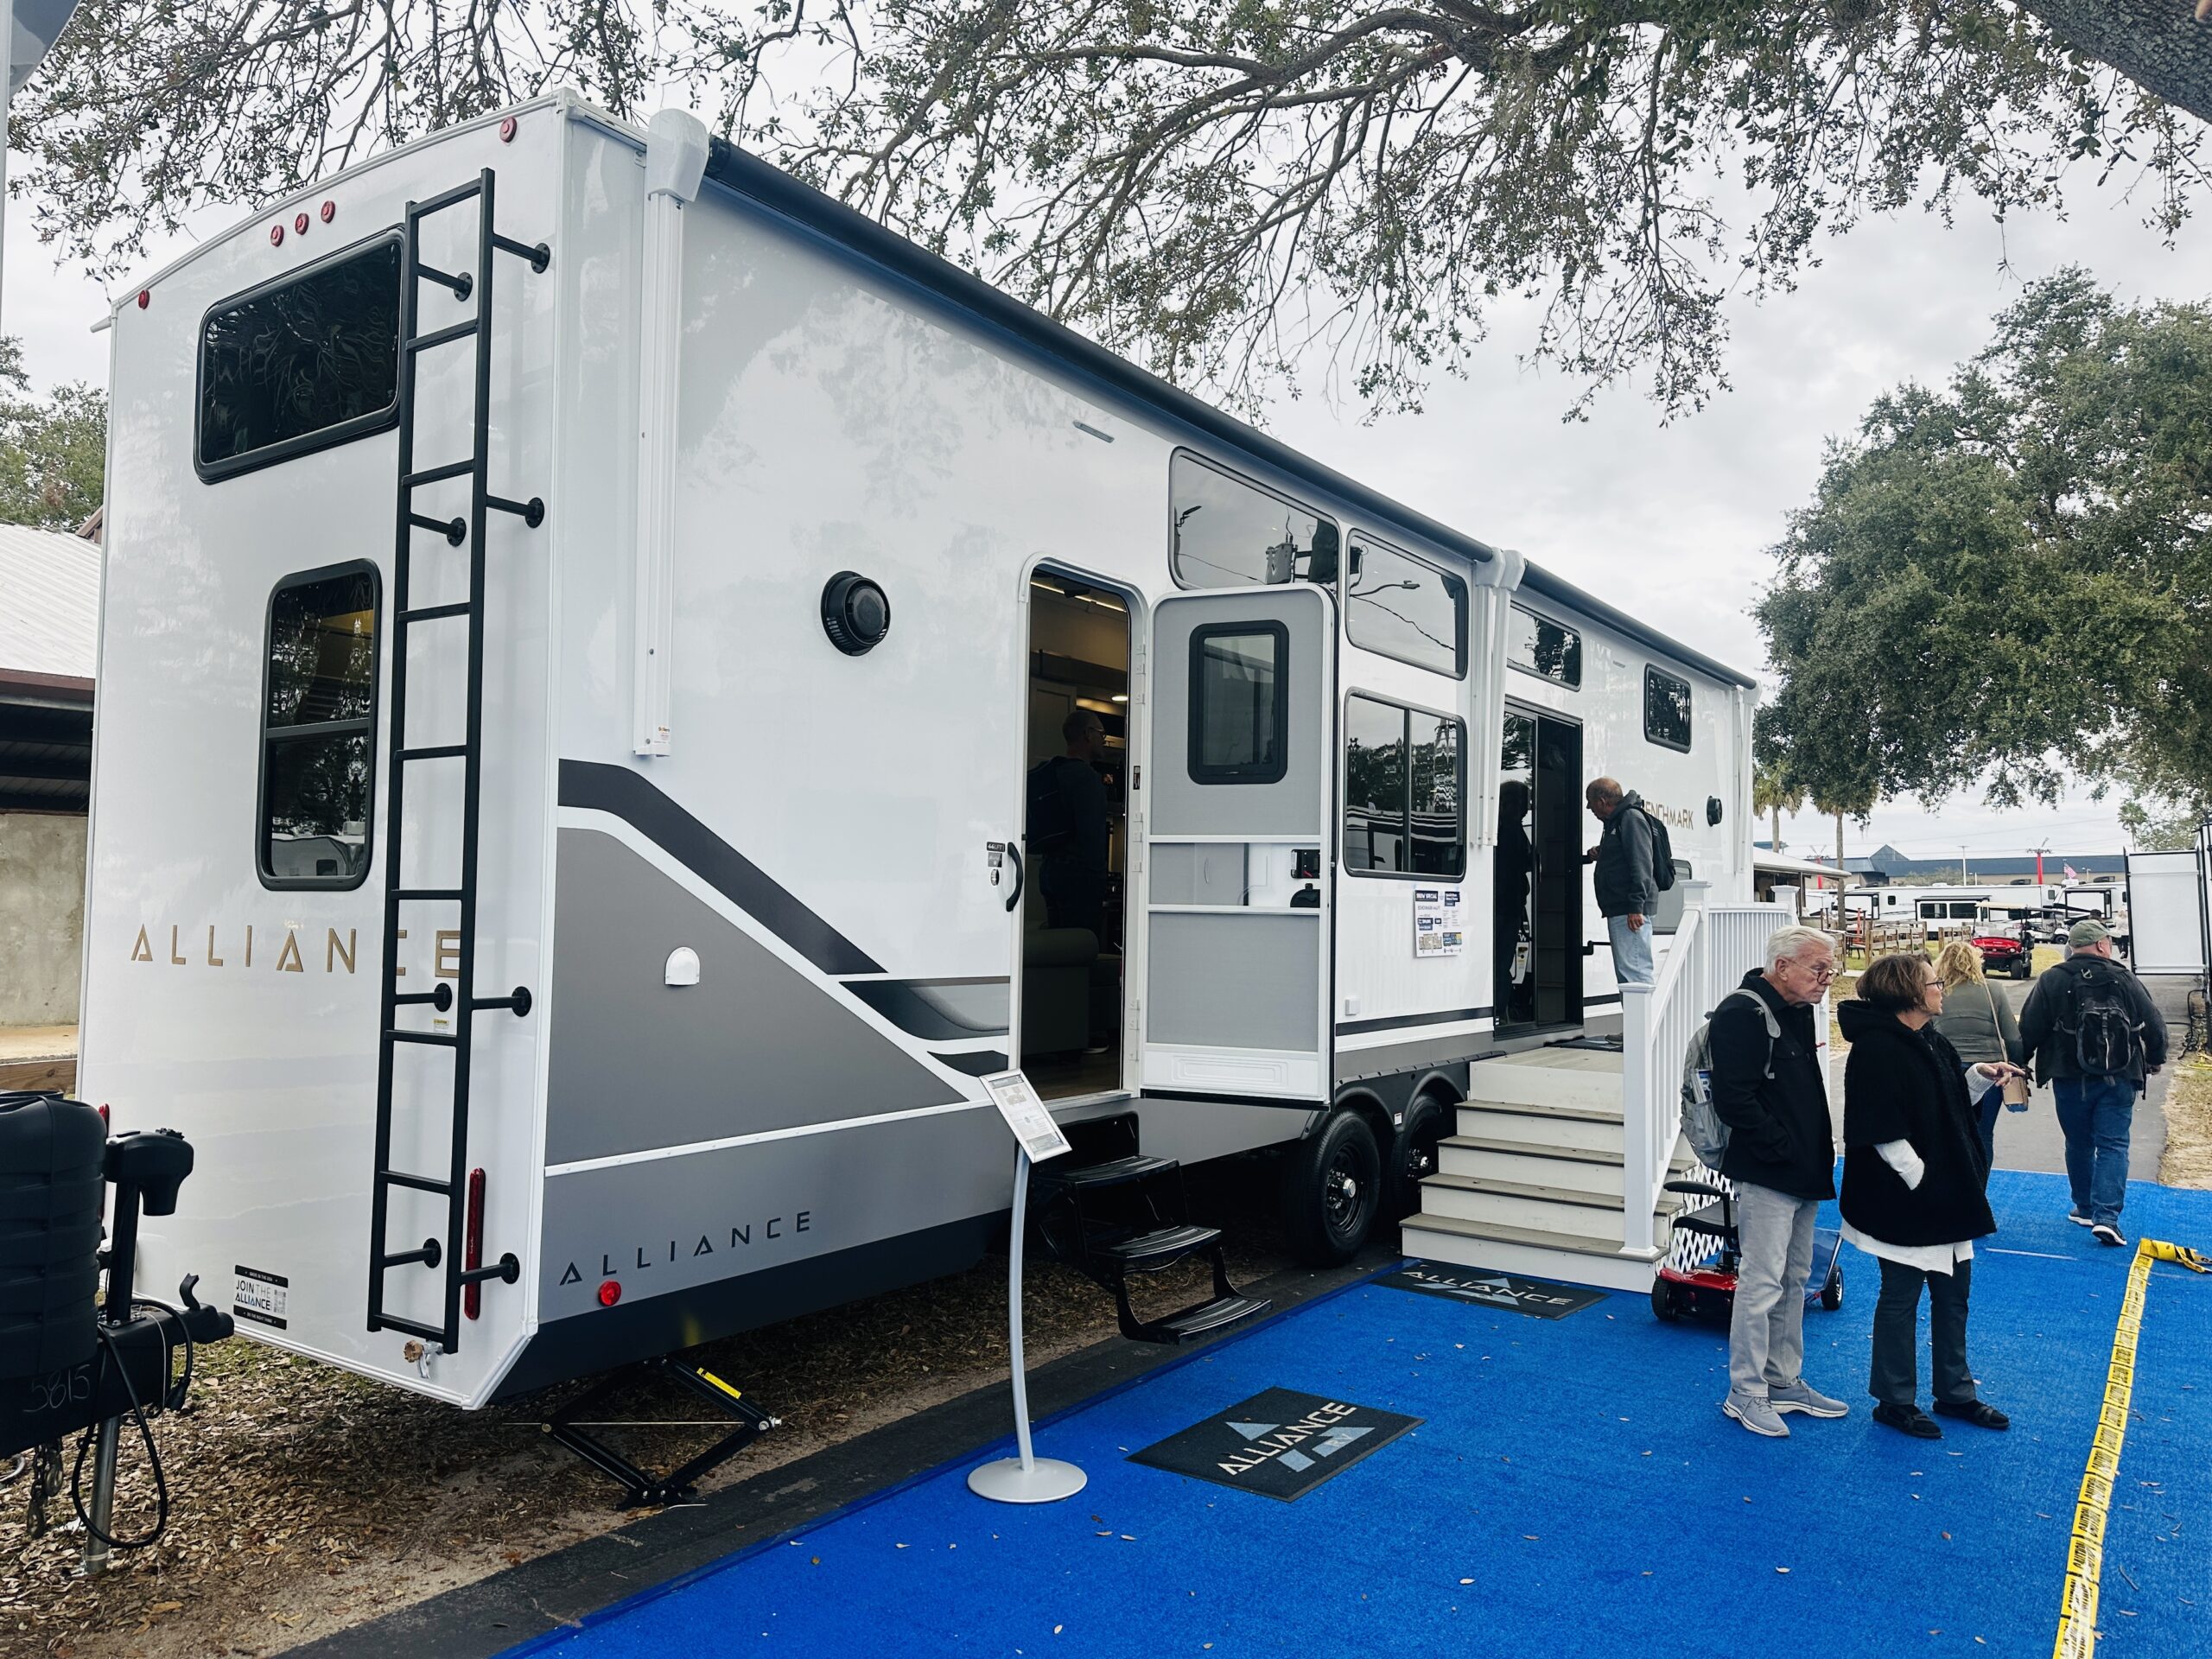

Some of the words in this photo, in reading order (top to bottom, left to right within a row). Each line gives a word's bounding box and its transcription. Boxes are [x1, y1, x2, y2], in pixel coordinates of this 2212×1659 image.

[1644, 800, 1694, 830] ENCHMARK
[130, 923, 461, 978] ALLIANE
[559, 1211, 810, 1286] ALLIANCE
[235, 1292, 270, 1311] ALLIANCE
[236, 1279, 254, 1294] JOIN
[255, 1284, 271, 1299] THE
[1401, 1271, 1573, 1306] ALLIANCE
[22, 1363, 91, 1413] 5815
[1217, 1402, 1357, 1476] ALLIANCE
[1324, 1433, 1353, 1447] RV
[2078, 1506, 2089, 1533] CAUTION
[2073, 1540, 2086, 1569] CAUTION
